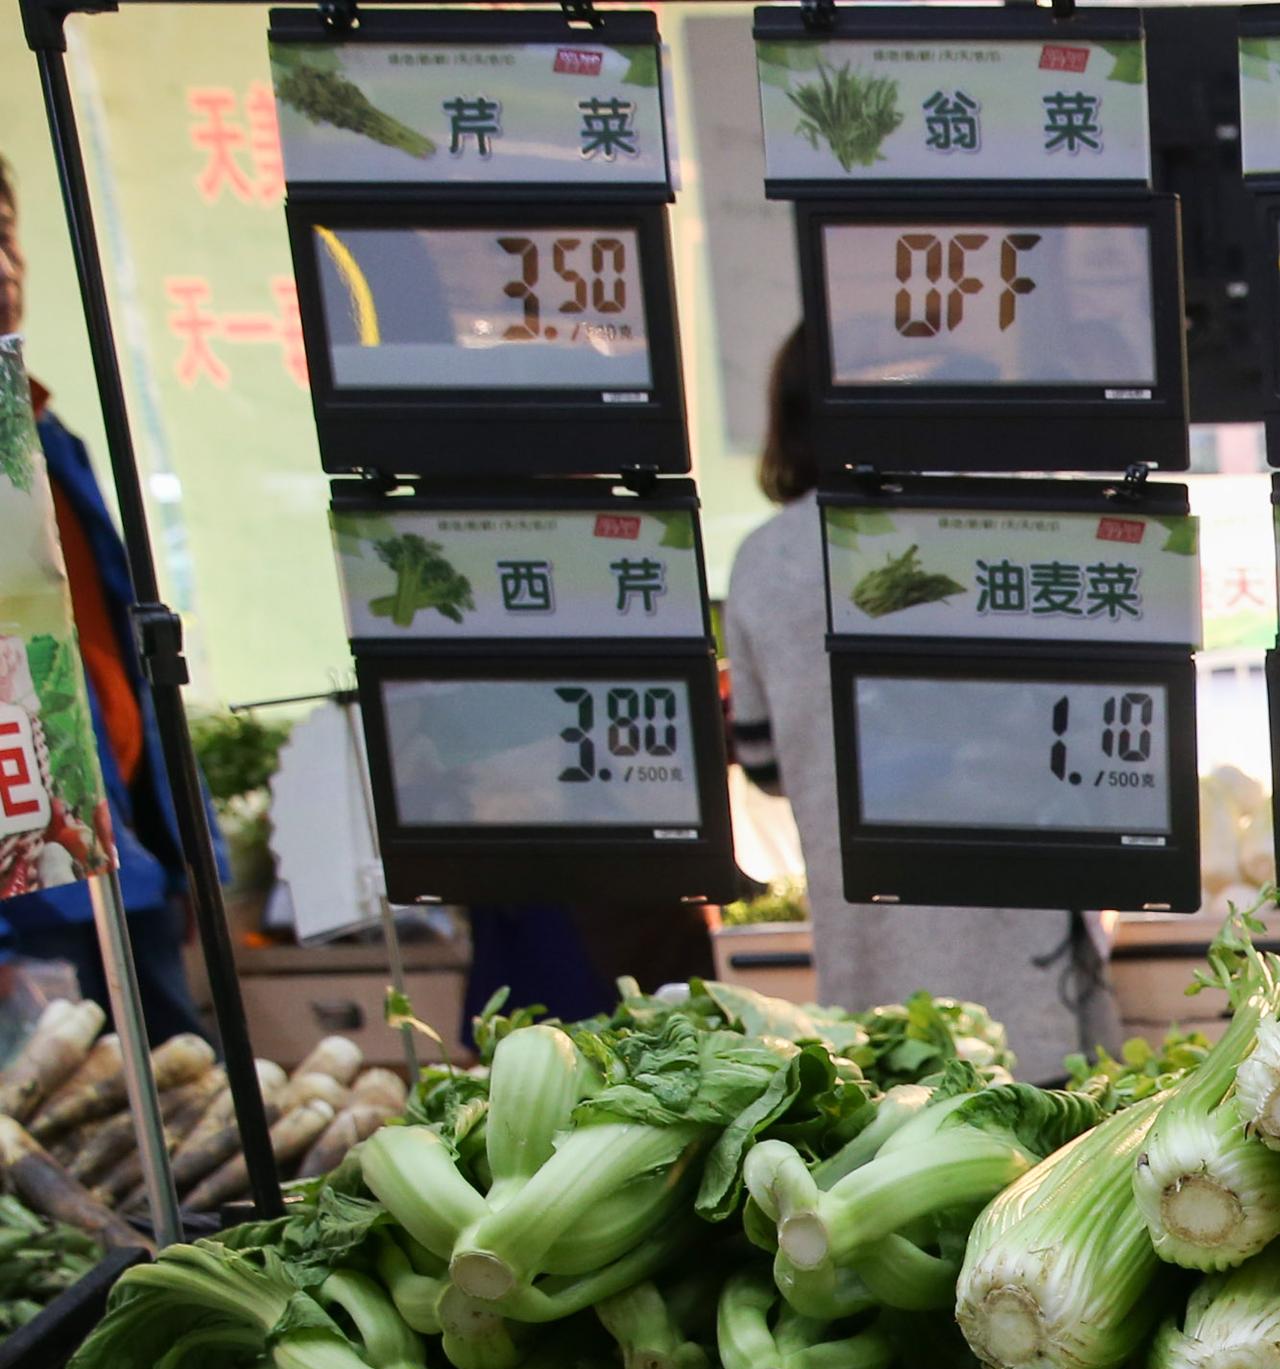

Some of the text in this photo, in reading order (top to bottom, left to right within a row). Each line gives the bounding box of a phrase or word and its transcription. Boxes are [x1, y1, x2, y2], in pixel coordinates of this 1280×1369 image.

[441, 96, 638, 157] 芹菜
[922, 90, 1100, 151] 翁菜
[496, 236, 627, 342] 3.50
[496, 557, 663, 612] 西芹
[975, 558, 1140, 617] 油麦菜
[553, 687, 677, 782] 3.80
[1050, 692, 1154, 786] 1.10
[623, 766, 684, 783] /500克
[1093, 769, 1156, 788] /500克
